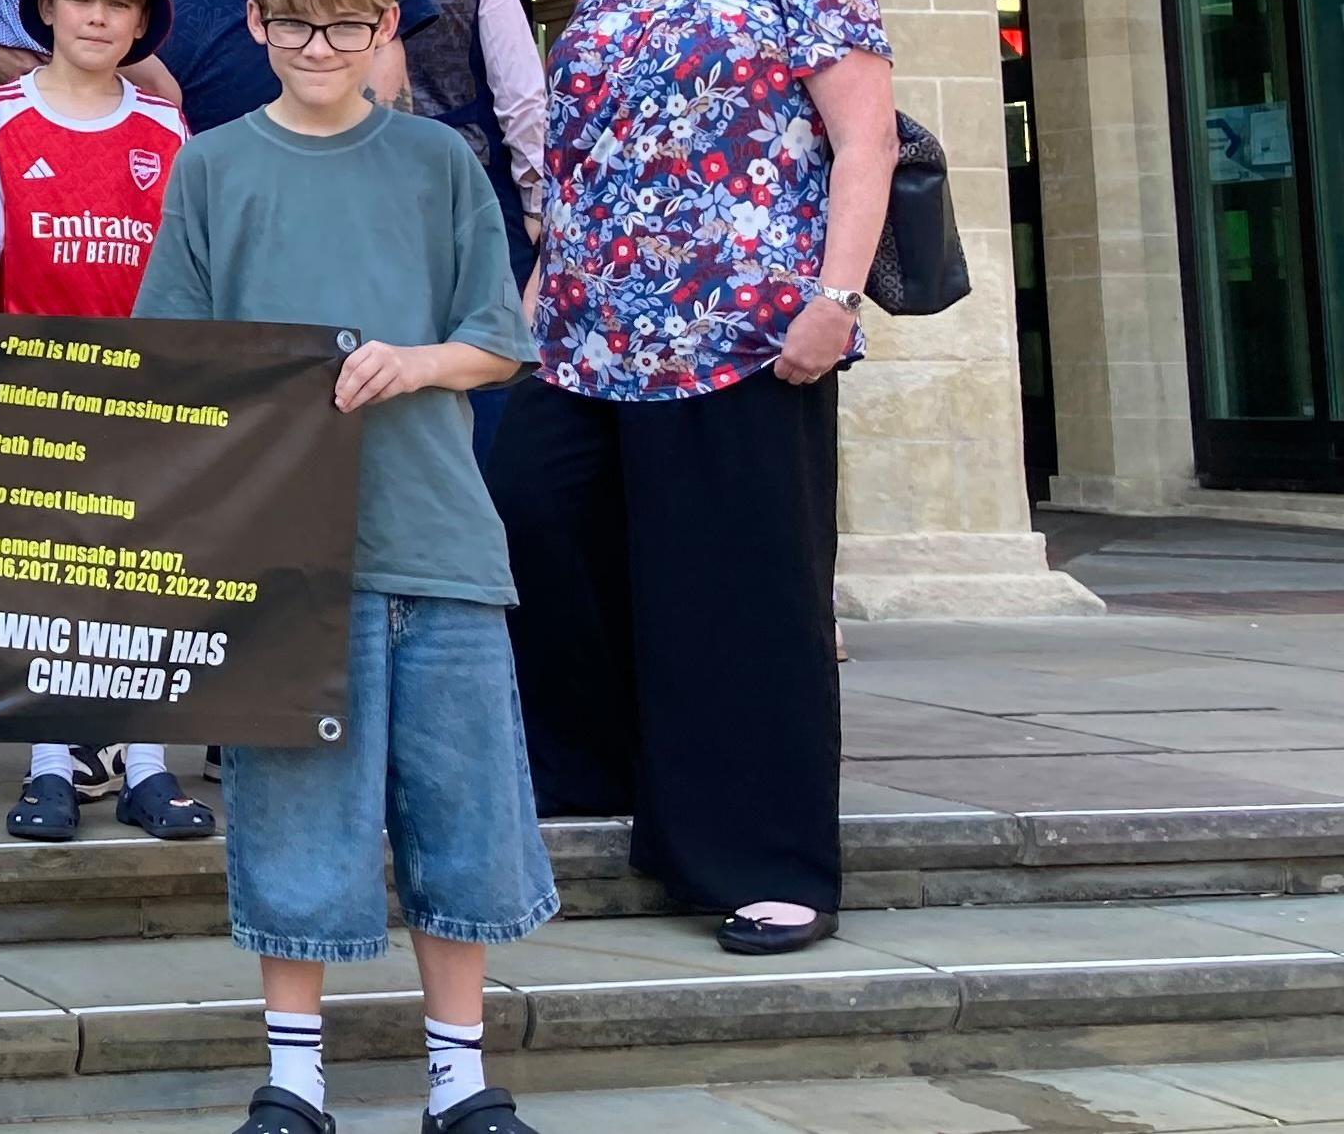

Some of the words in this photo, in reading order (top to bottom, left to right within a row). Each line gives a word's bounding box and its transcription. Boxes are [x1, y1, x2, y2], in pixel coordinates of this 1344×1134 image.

[30, 210, 154, 244] Emirates
[53, 241, 81, 264] FLY
[85, 241, 141, 267] BETTER
[46, 339, 63, 360] is
[66, 342, 102, 365] NOT
[102, 348, 141, 369] safe
[61, 391, 103, 414] from
[103, 398, 174, 423] passing
[175, 404, 229, 428] traffic
[32, 437, 87, 462] floods
[9, 488, 63, 510] street
[64, 491, 136, 520] lighting
[54, 543, 117, 567] unsafe
[119, 547, 137, 568] in
[139, 550, 186, 575] 2007,
[64, 564, 111, 591] 2018,
[114, 570, 162, 596] 2020,
[165, 575, 212, 601] 2022,
[214, 580, 258, 603] 2023
[78, 620, 168, 663] WHAT
[168, 629, 228, 667] HAS
[27, 656, 166, 701] CHANGED
